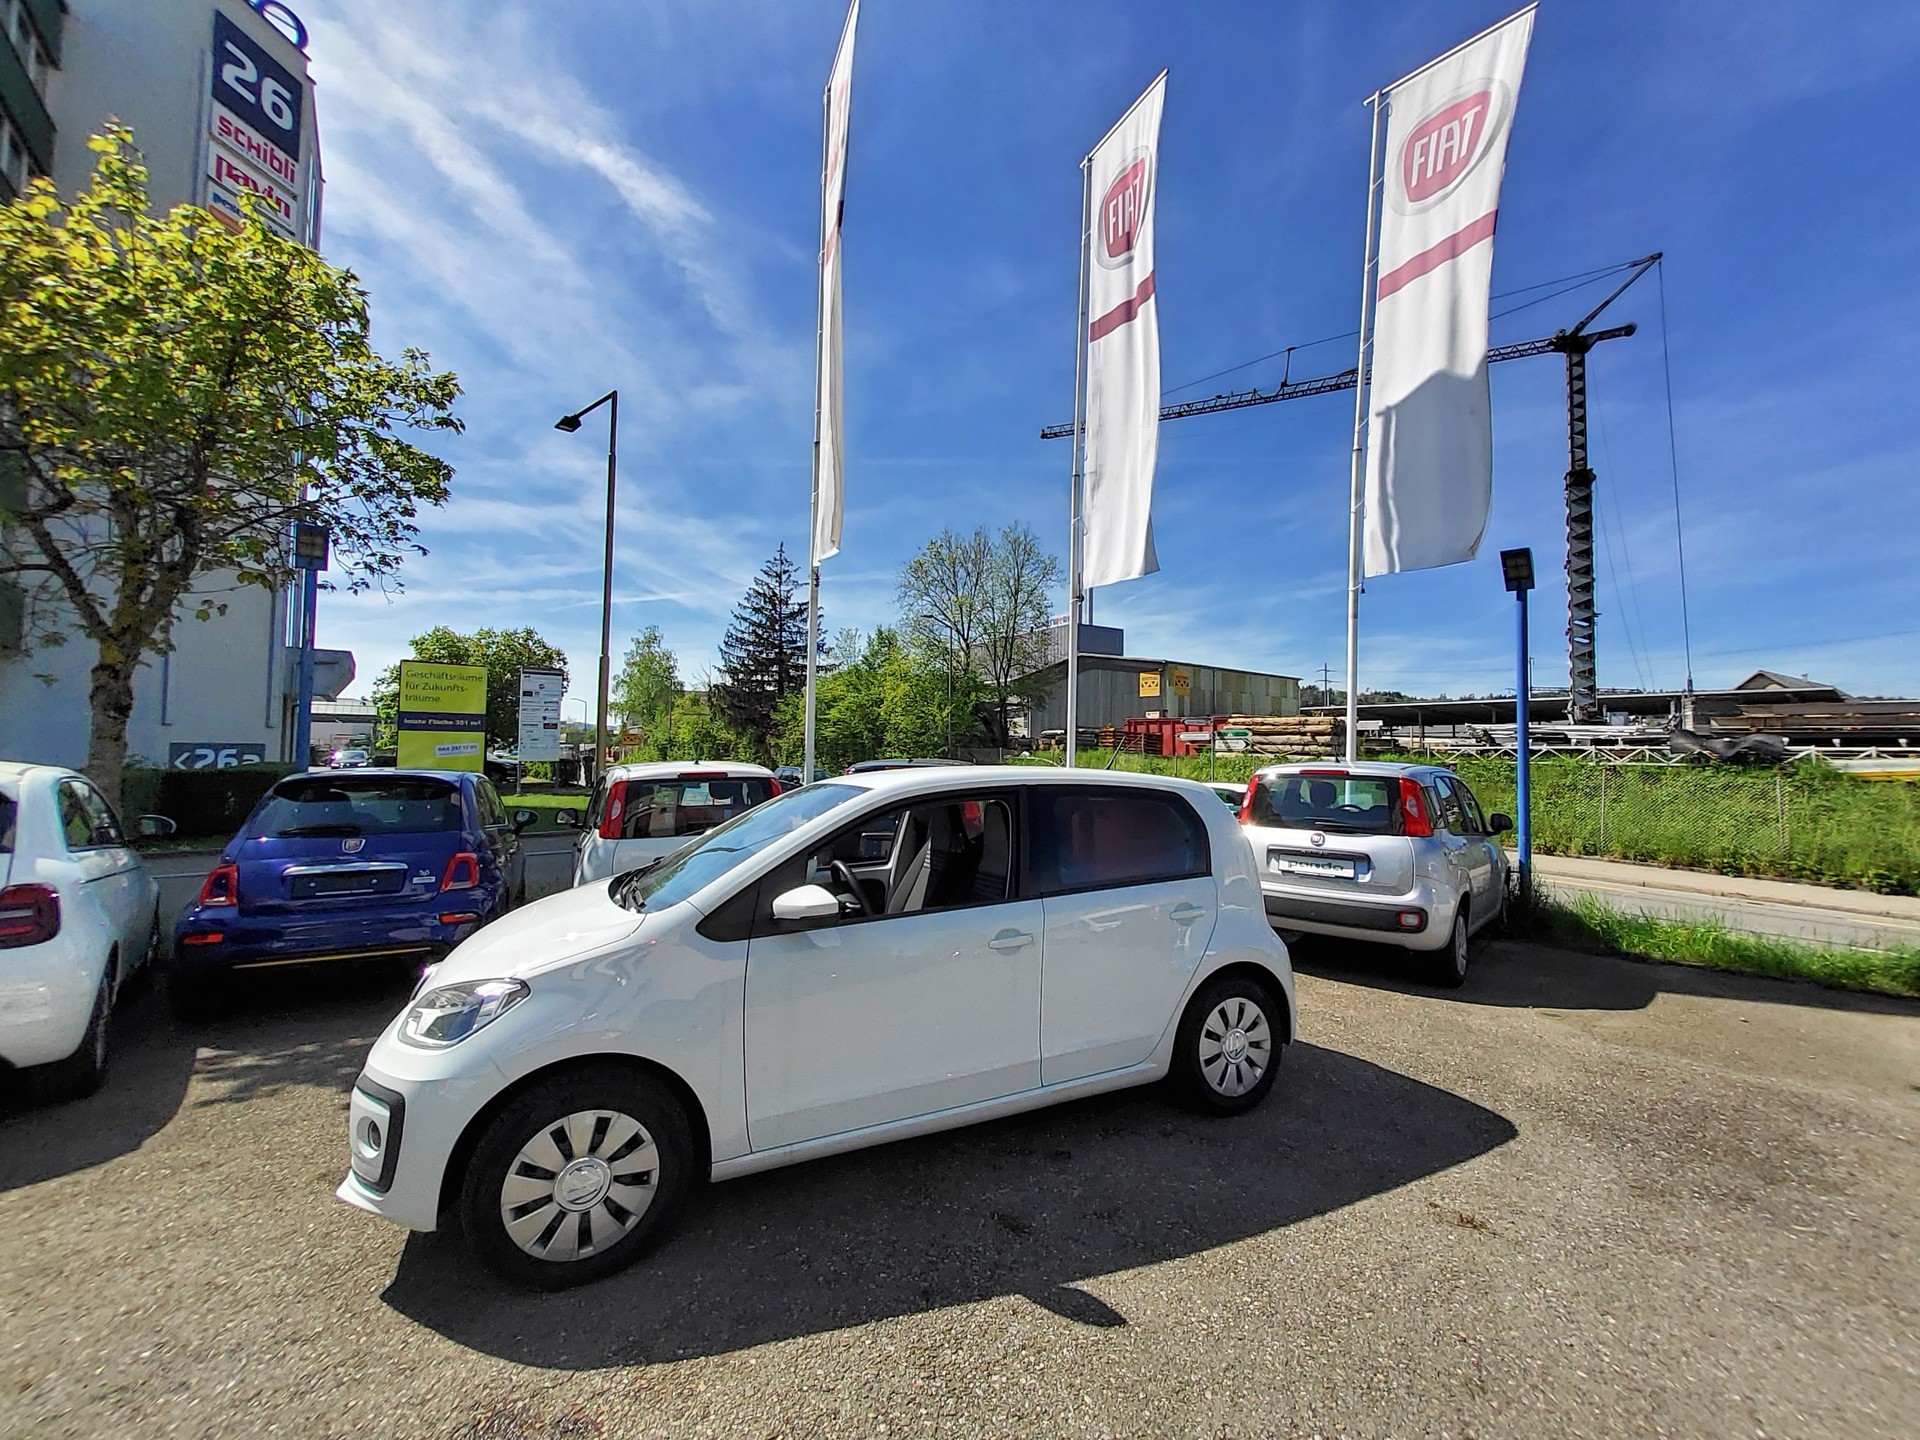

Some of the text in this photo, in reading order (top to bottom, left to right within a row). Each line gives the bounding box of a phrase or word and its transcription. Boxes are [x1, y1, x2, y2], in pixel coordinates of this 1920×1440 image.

[222, 39, 294, 131] 26
[1410, 104, 1483, 189] FIAT
[1109, 171, 1142, 245] FIAT
[405, 681, 420, 691] für
